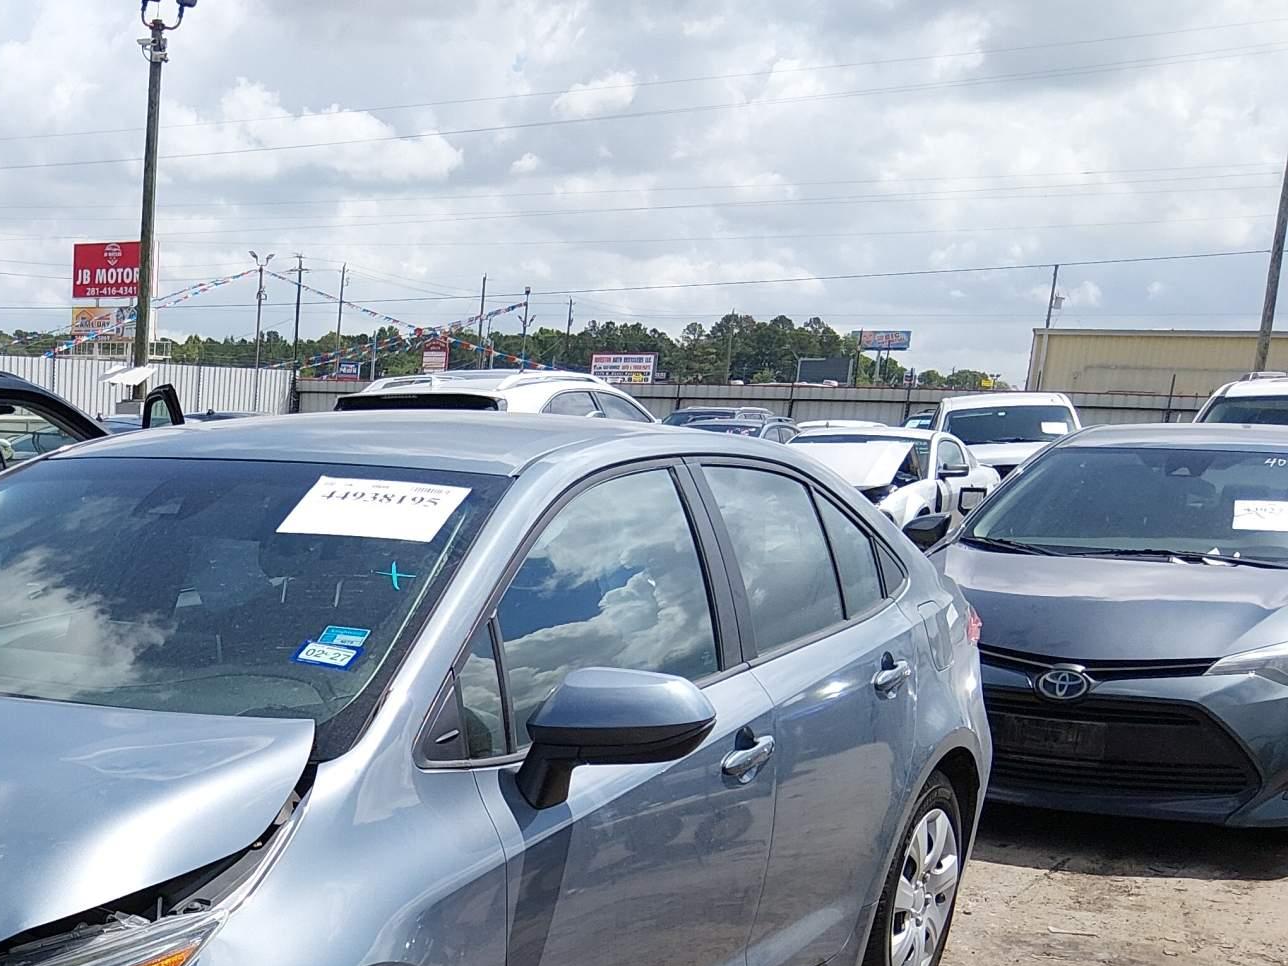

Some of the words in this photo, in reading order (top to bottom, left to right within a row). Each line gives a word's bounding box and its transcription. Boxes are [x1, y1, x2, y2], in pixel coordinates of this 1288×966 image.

[76, 269, 91, 285] JB
[86, 286, 137, 296] 281-416-4341
[321, 489, 441, 508] 44938195
[305, 648, 322, 658] 02
[329, 652, 352, 662] 27
